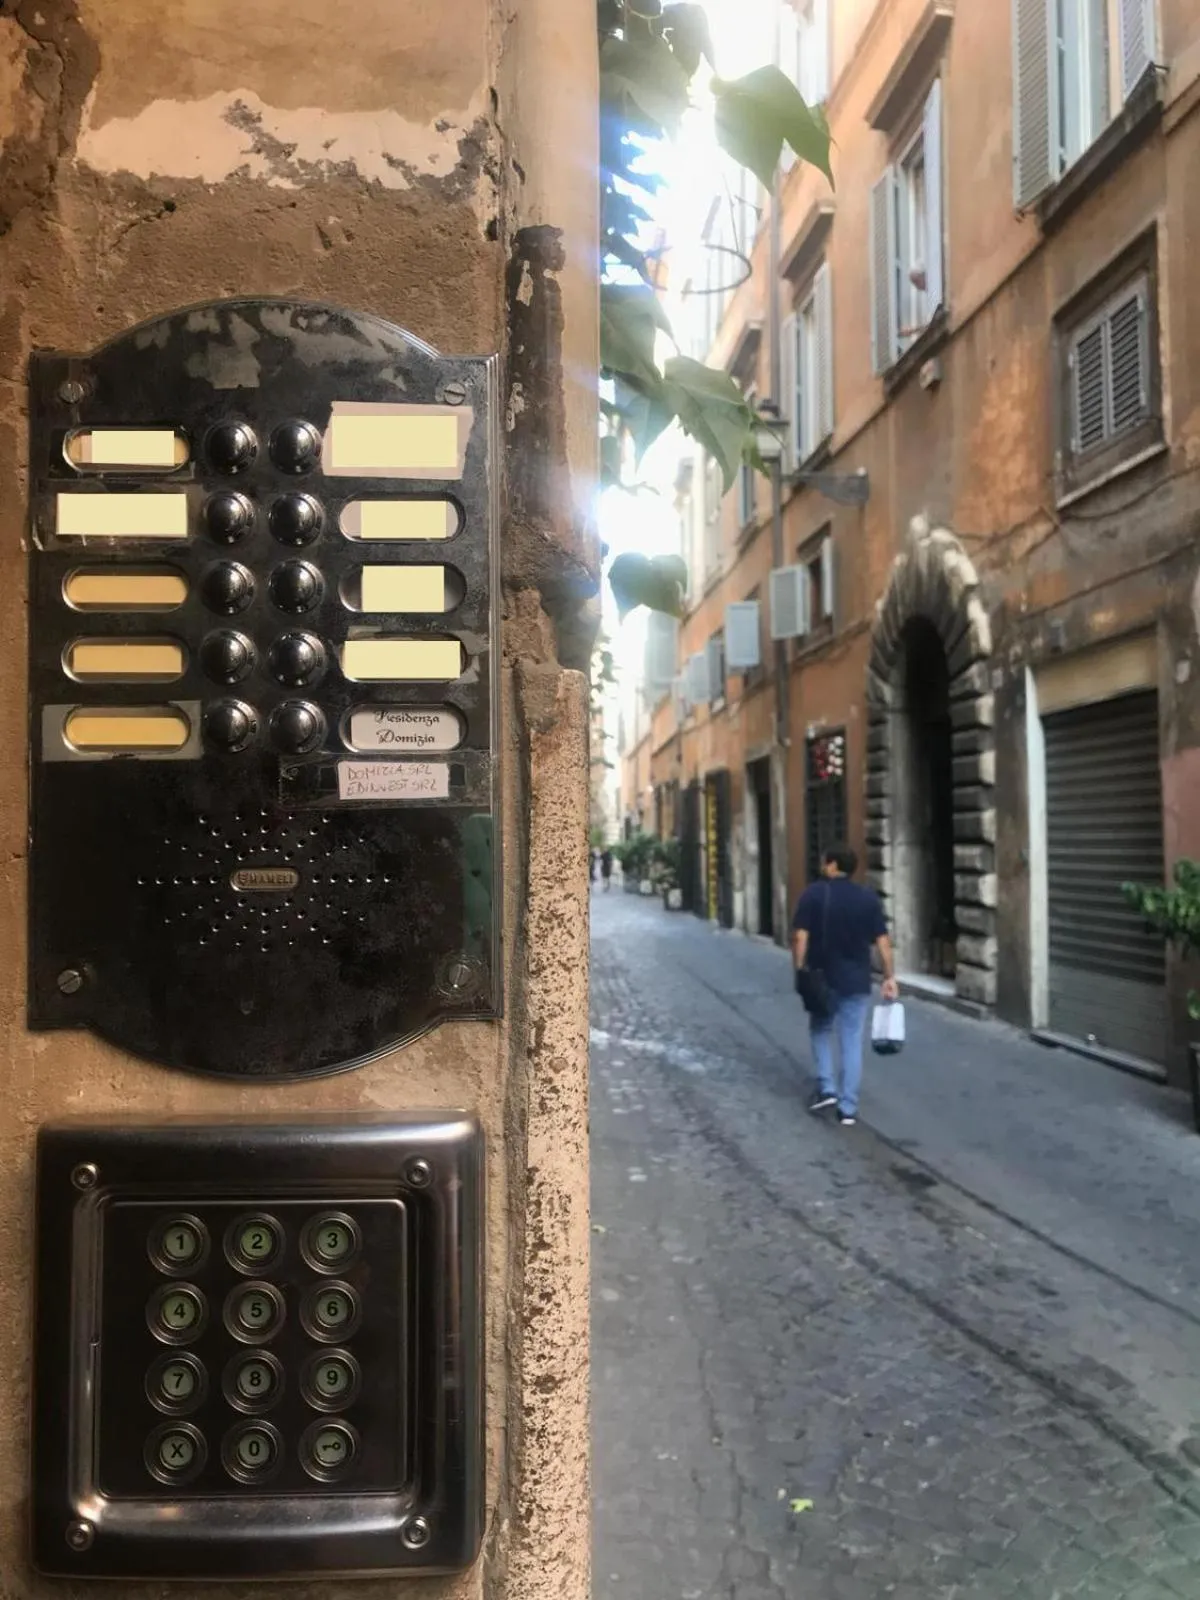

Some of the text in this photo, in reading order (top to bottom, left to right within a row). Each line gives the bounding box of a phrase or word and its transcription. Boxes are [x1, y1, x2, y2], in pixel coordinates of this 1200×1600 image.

[374, 710, 440, 726] Residenza
[376, 729, 435, 747] Domizia
[176, 1234, 184, 1250] 1
[251, 1233, 262, 1249] 2
[327, 1232, 338, 1248] 3
[174, 1304, 185, 1319] 4
[251, 1303, 262, 1318] 5
[327, 1301, 338, 1317] 6
[173, 1373, 184, 1389] 7
[250, 1371, 261, 1387] 8
[327, 1370, 338, 1386] 9
[171, 1443, 184, 1459] X
[248, 1441, 259, 1457] 0
